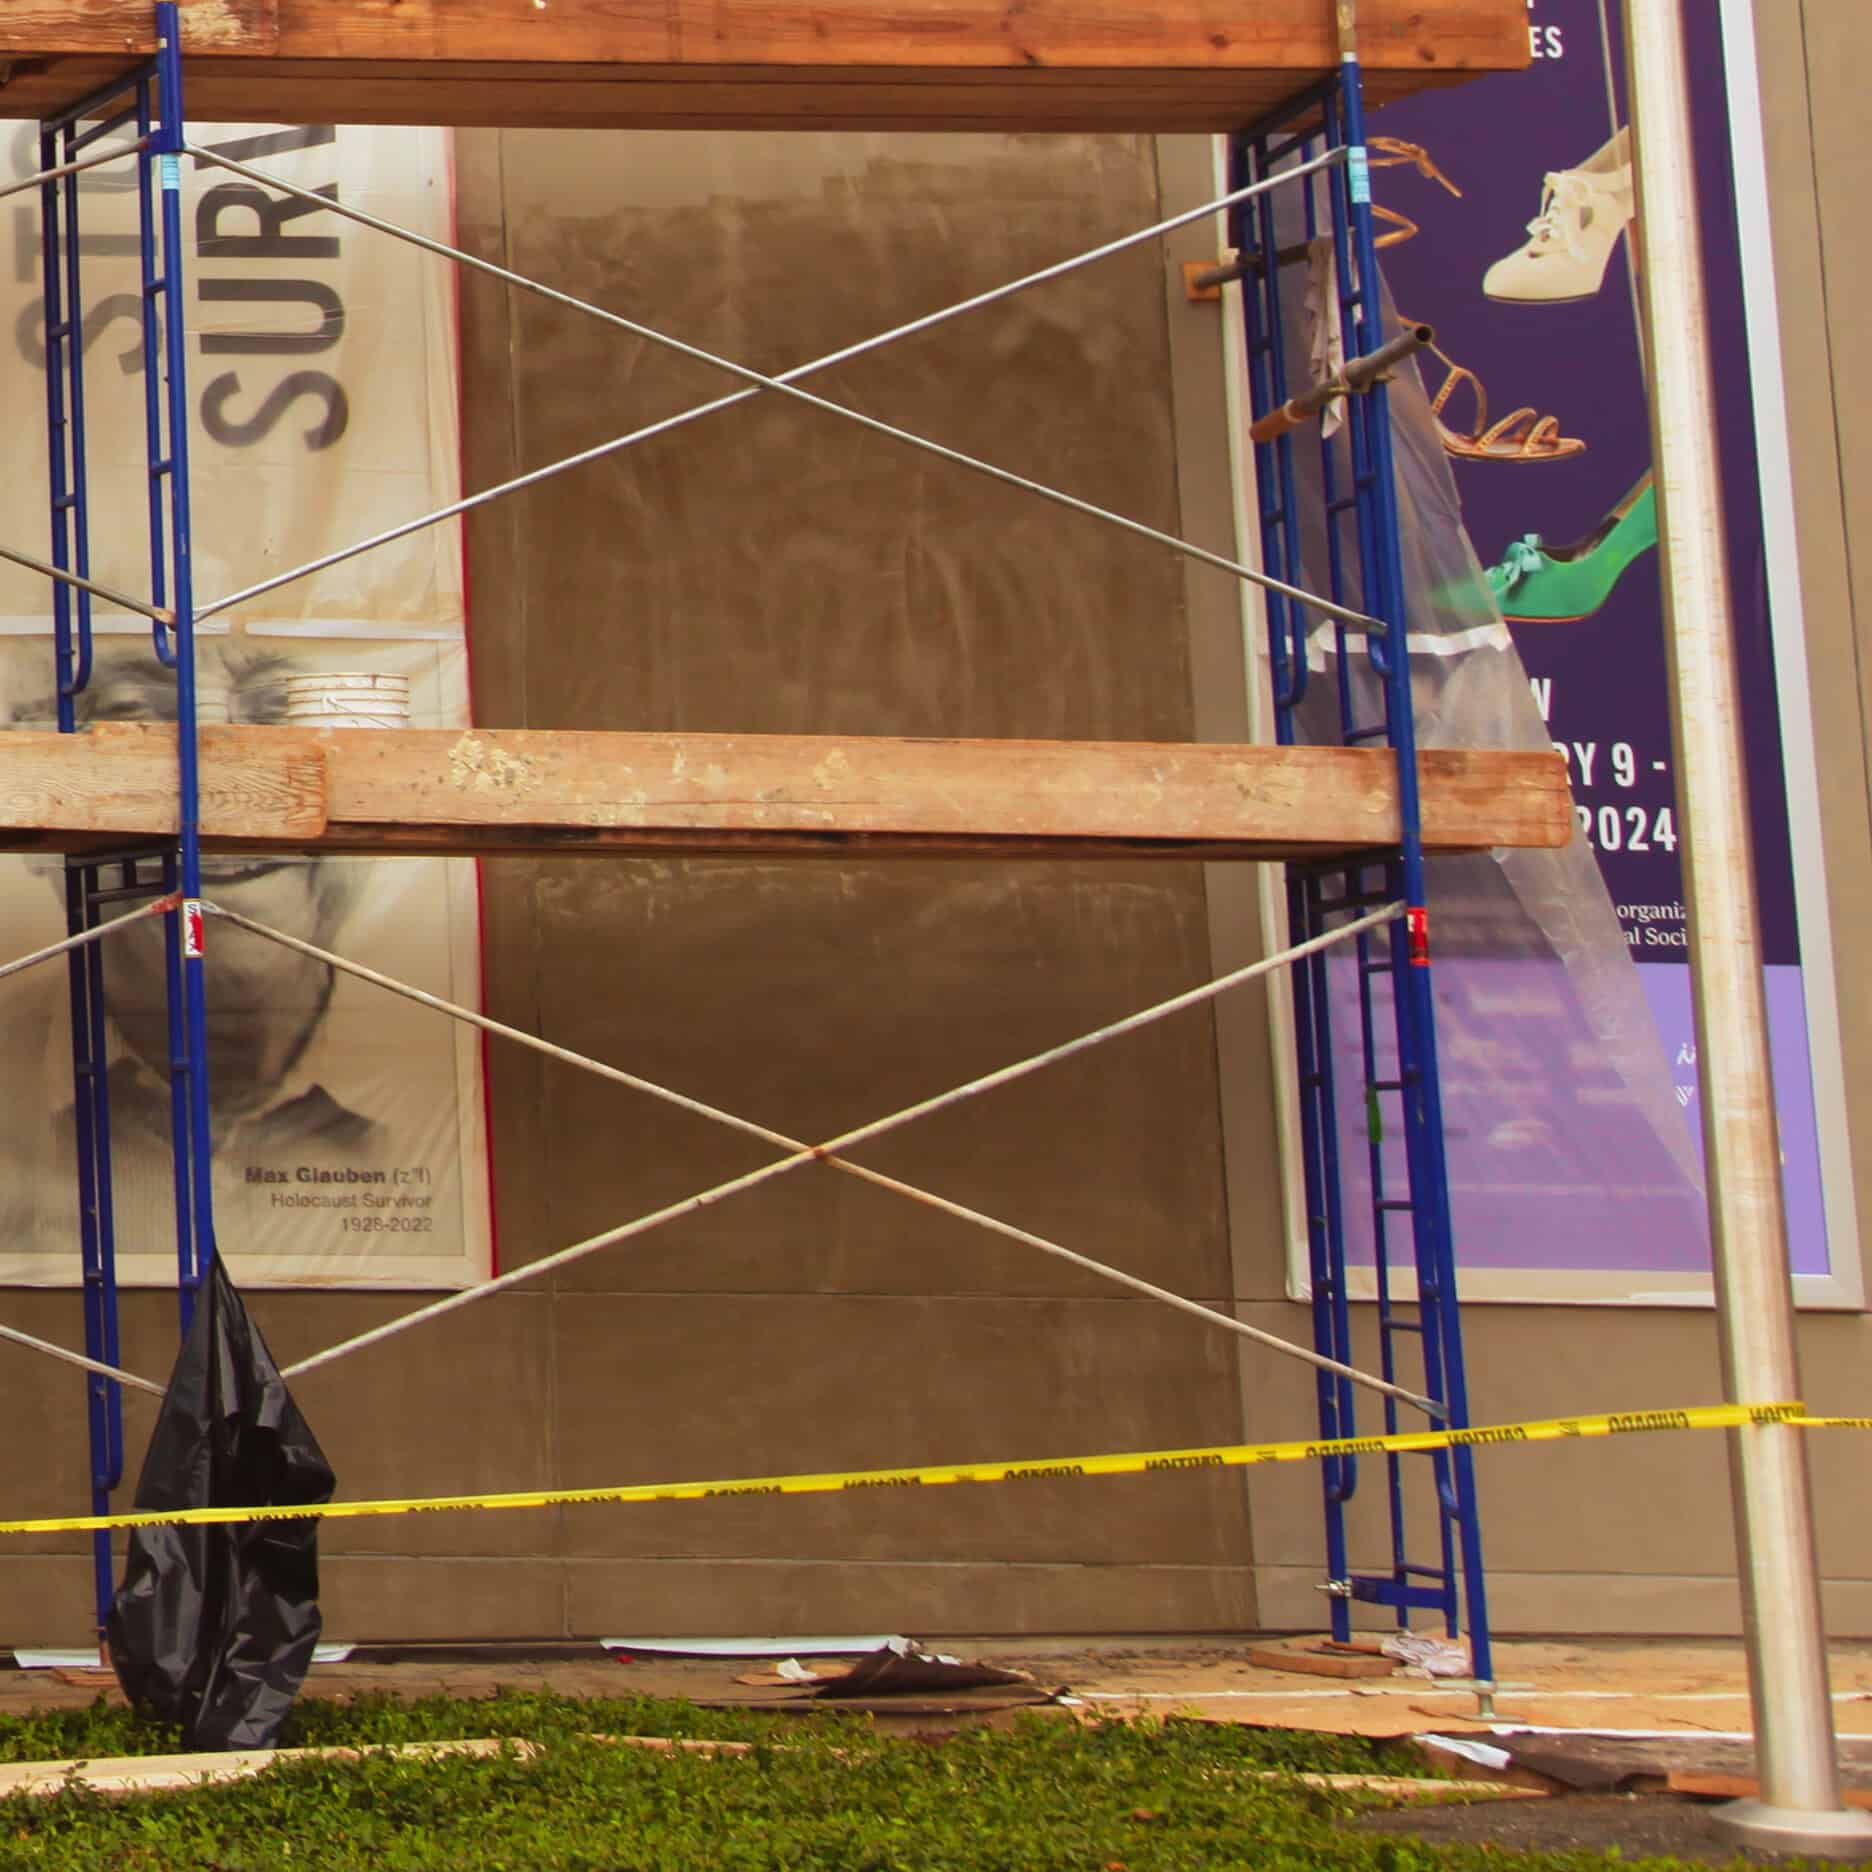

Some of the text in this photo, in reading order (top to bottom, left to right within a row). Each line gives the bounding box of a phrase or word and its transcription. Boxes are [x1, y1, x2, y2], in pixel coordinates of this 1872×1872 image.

[244, 1167, 289, 1185] Max
[295, 1166, 386, 1185] Glauben
[270, 1192, 433, 1209] Holocaust Survivor
